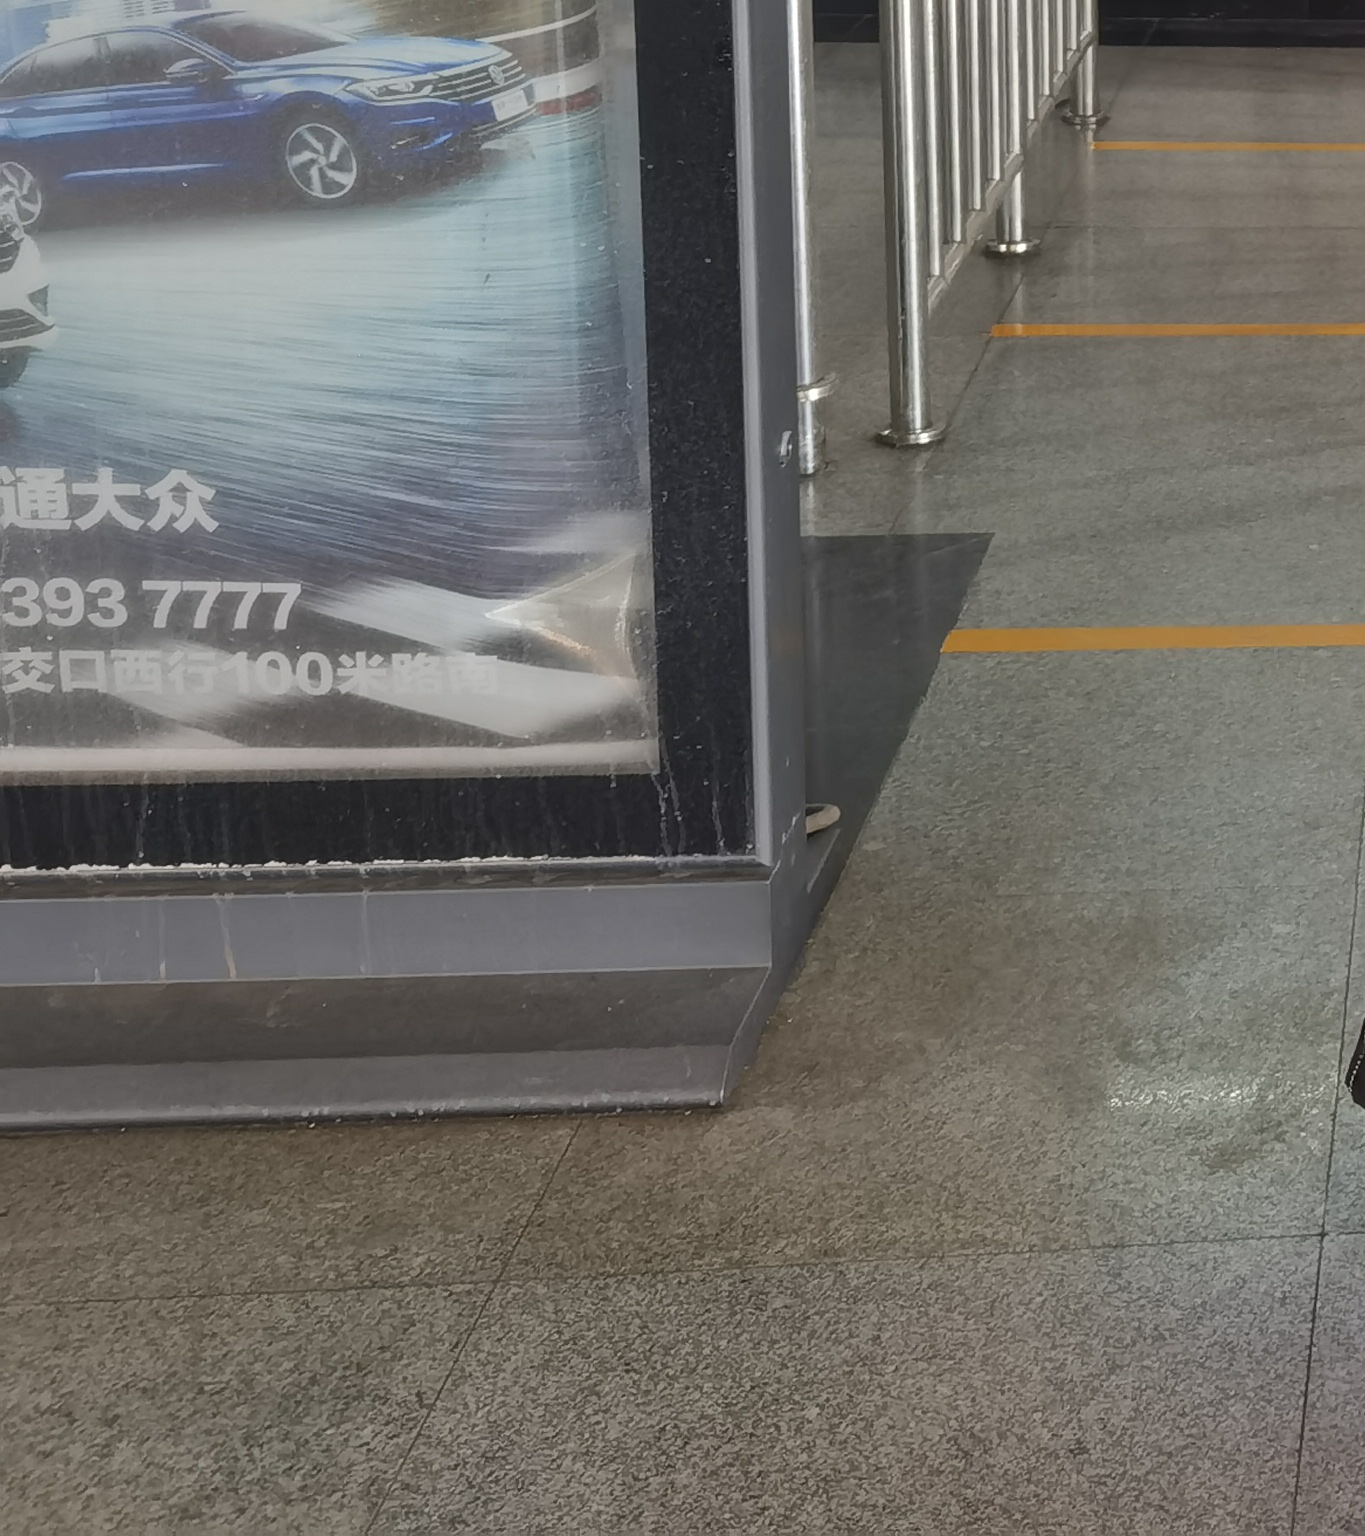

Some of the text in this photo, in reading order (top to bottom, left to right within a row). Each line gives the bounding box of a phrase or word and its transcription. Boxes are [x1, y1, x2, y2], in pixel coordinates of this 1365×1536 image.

[0, 466, 220, 534] 通大众
[141, 579, 302, 631] 7777
